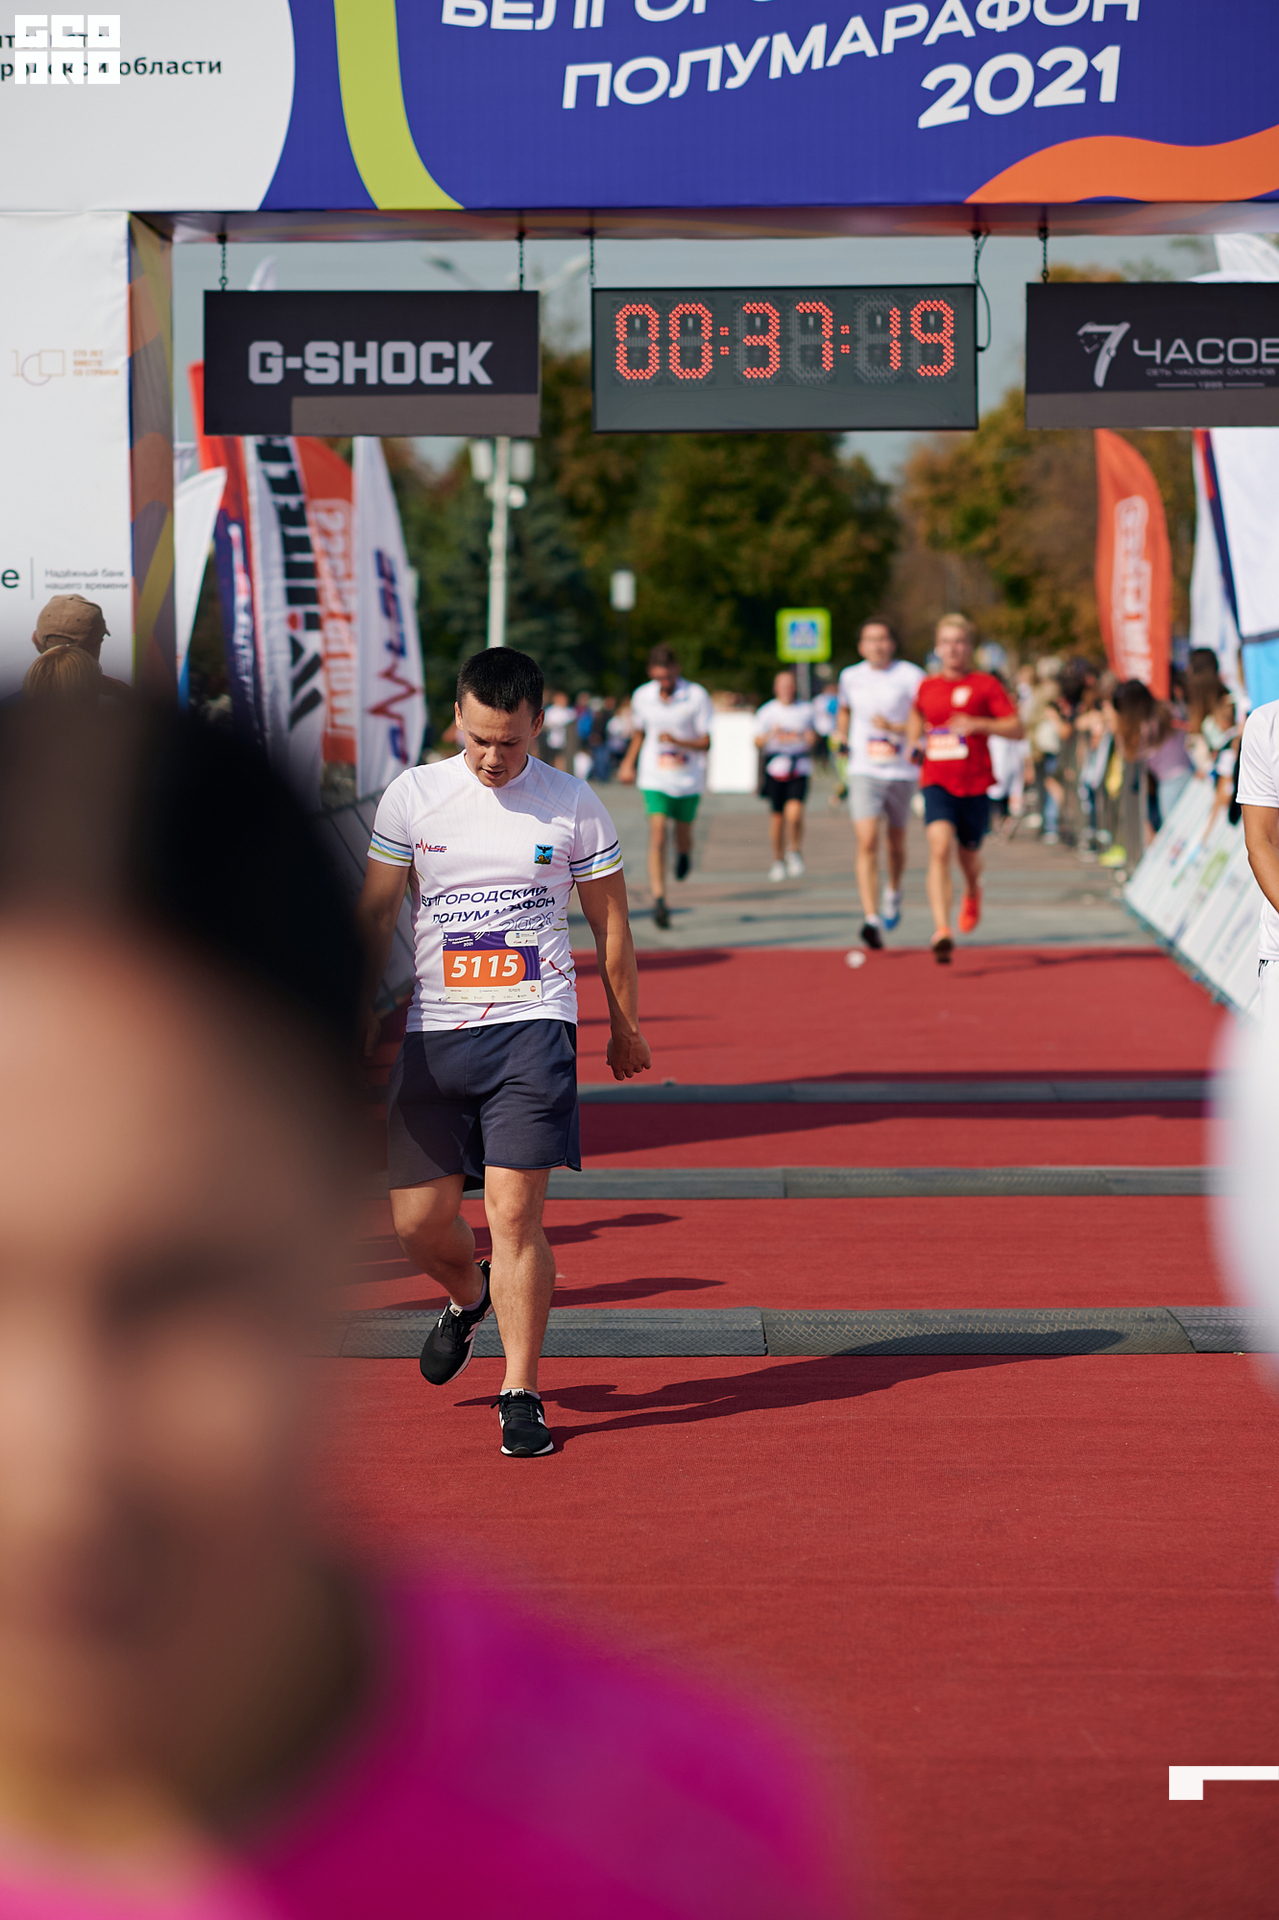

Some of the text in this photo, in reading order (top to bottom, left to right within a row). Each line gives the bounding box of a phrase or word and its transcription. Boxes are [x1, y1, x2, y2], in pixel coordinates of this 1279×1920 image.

[119, 56, 222, 75] области
[917, 45, 1121, 129] 2021
[615, 299, 955, 380] 00:37:19
[248, 341, 494, 385] G-SHOCK
[451, 954, 519, 978] 5115
